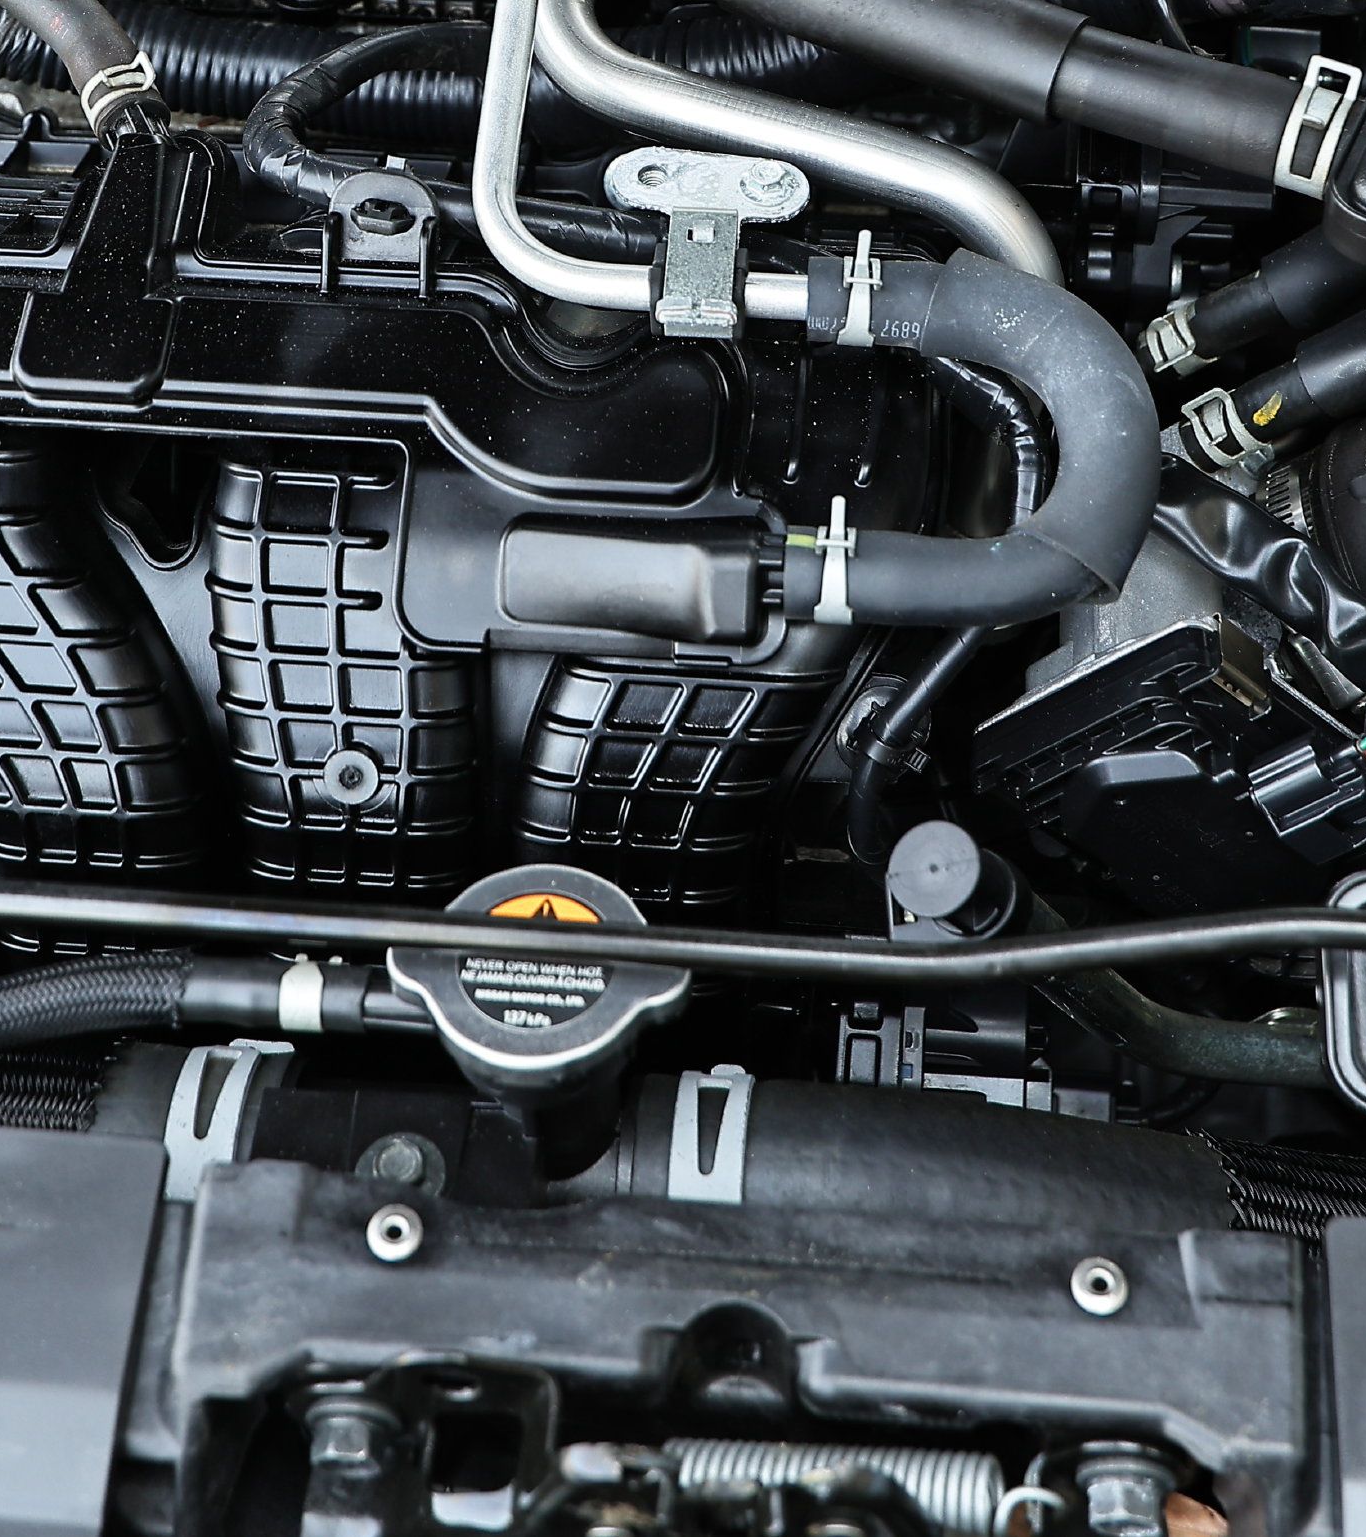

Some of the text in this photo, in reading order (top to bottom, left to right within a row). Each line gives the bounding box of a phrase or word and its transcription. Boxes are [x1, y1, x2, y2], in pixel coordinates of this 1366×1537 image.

[466, 957, 504, 970] NEVER
[505, 959, 539, 974] OPEN
[540, 962, 576, 977] WHEN
[460, 968, 477, 982] NE
[477, 970, 514, 985] JAMAIS
[514, 973, 555, 989] OUVRIR
